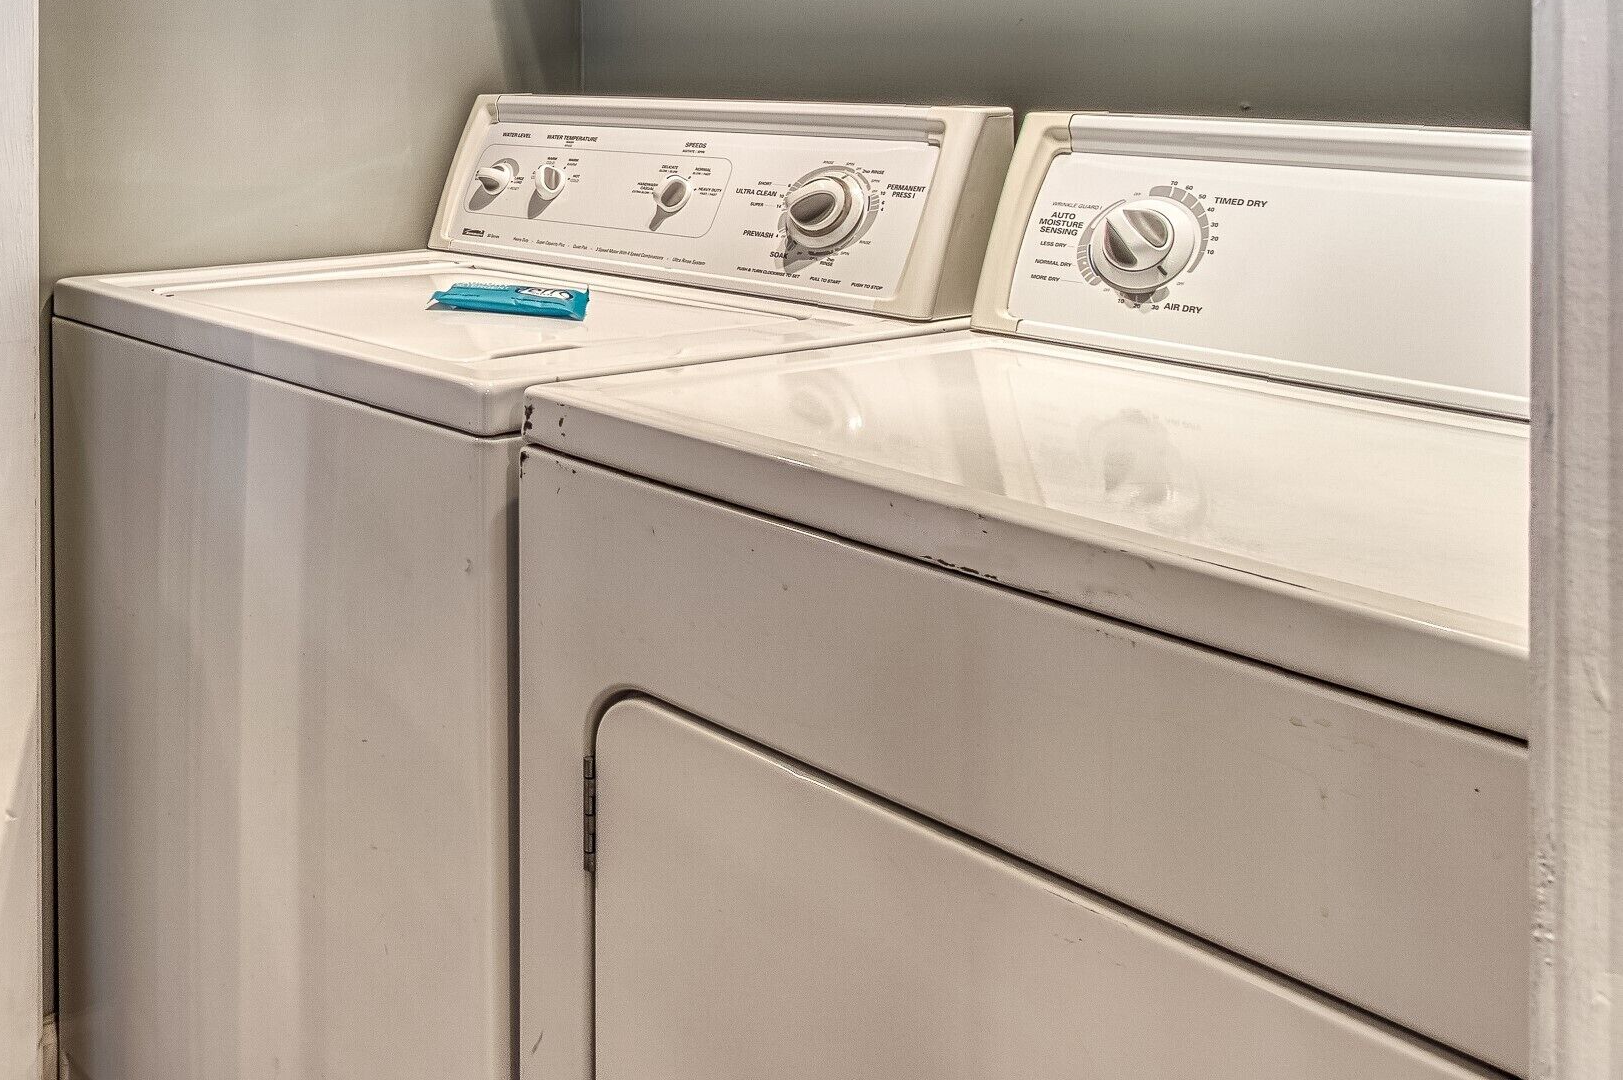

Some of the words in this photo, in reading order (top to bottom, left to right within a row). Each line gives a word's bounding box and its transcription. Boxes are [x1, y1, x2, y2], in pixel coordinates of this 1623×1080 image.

[685, 141, 707, 149] SPEEDS
[886, 183, 926, 193] PERMANENT
[892, 191, 911, 199] PRESS
[1214, 197, 1244, 206] TIMED
[1247, 200, 1268, 208] DRY
[1051, 212, 1076, 220] AUTO
[1039, 218, 1084, 229] MOISTURE
[743, 230, 774, 238] PREWASH
[1040, 226, 1078, 236] SENSING
[770, 251, 788, 259] SOAK
[1164, 303, 1180, 311] AIR
[1182, 305, 1203, 314] DRY
